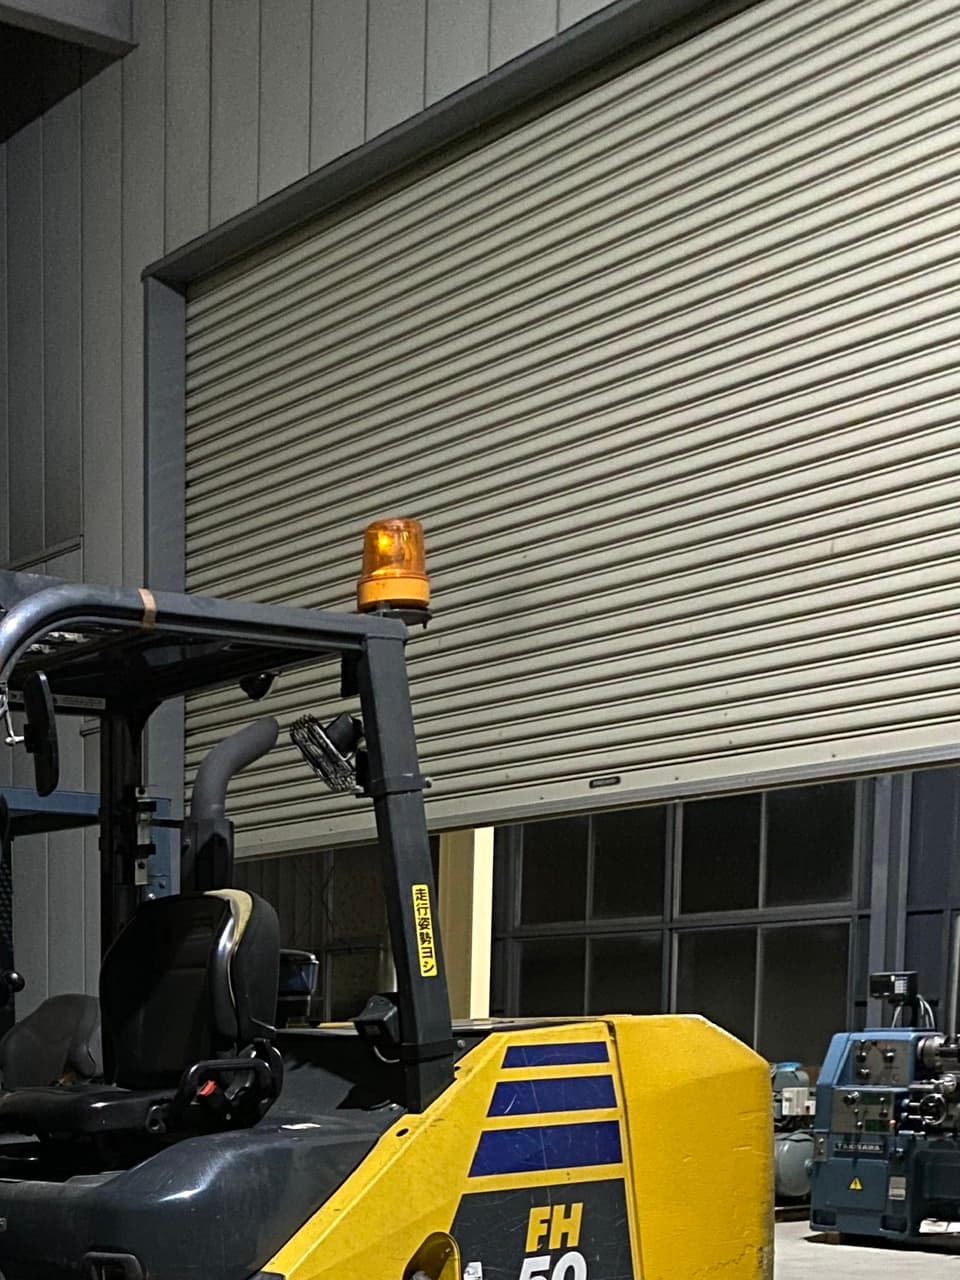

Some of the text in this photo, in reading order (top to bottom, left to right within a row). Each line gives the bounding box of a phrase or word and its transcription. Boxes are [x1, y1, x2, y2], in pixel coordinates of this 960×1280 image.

[415, 888, 435, 973] 走行姿勢ヨシ
[525, 1202, 584, 1253] FH
